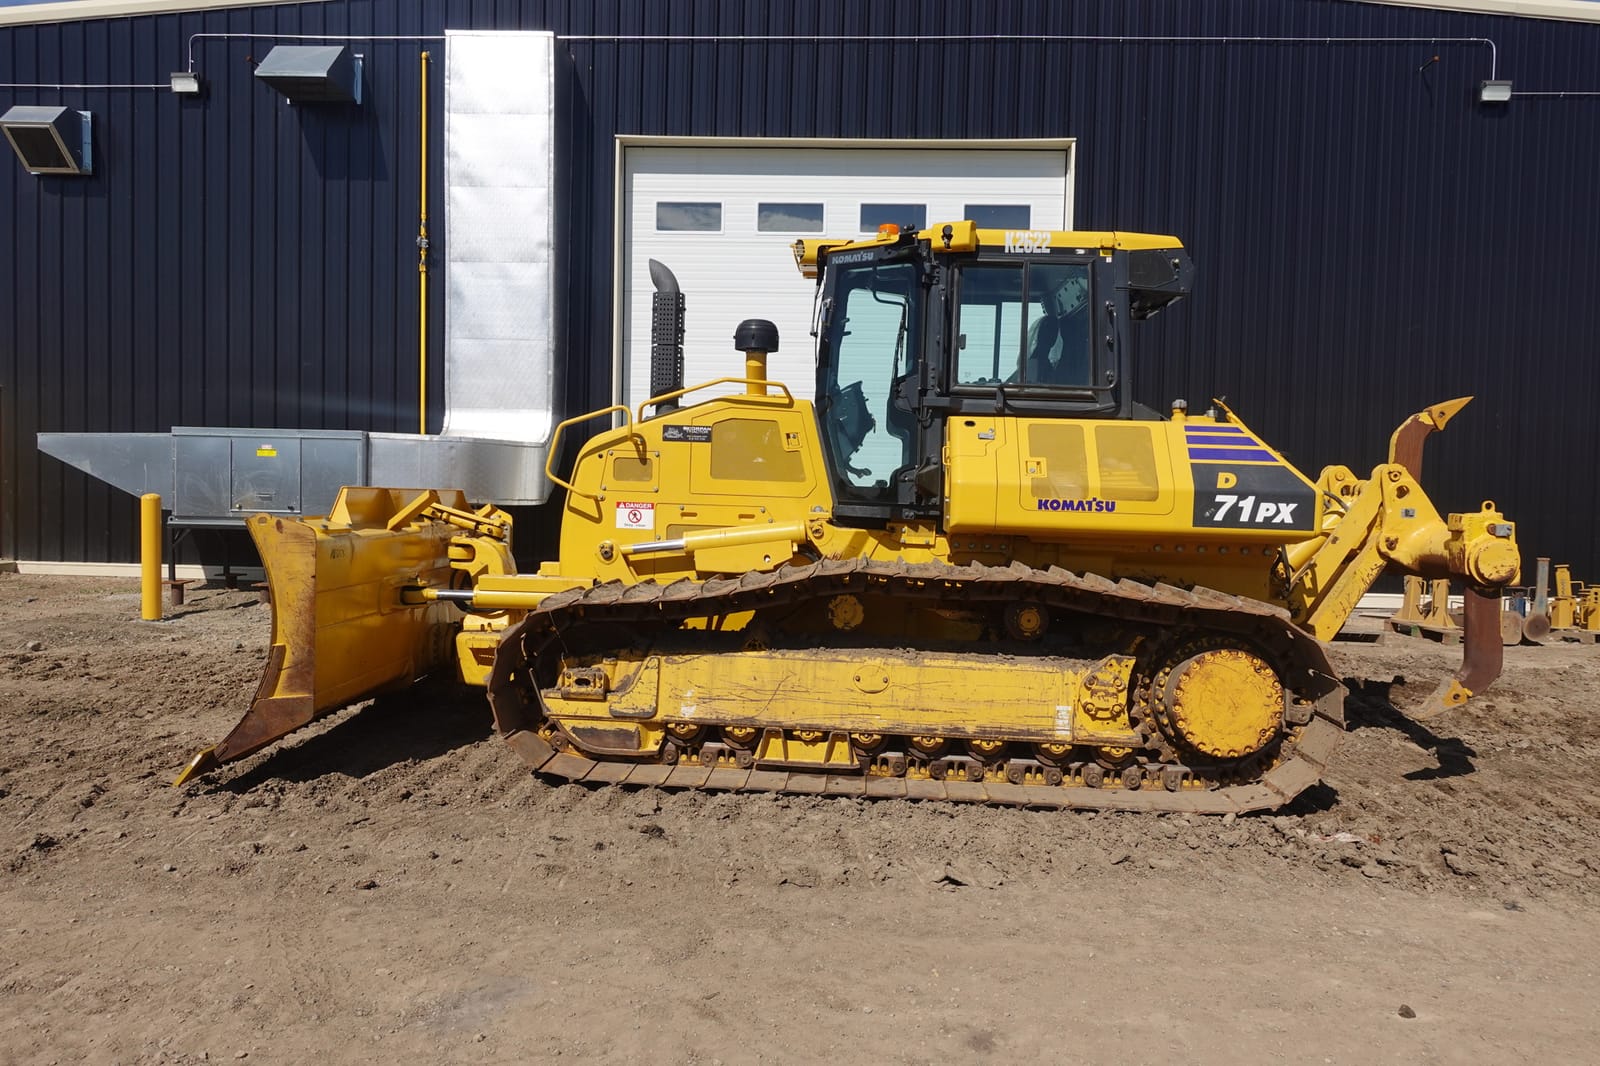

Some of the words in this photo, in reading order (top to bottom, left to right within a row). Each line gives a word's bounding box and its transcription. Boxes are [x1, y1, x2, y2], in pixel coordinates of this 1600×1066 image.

[1005, 232, 1051, 253] K2622
[832, 251, 874, 264] KOMATSU
[1217, 472, 1237, 489] D
[1038, 497, 1116, 512] KOMATSU
